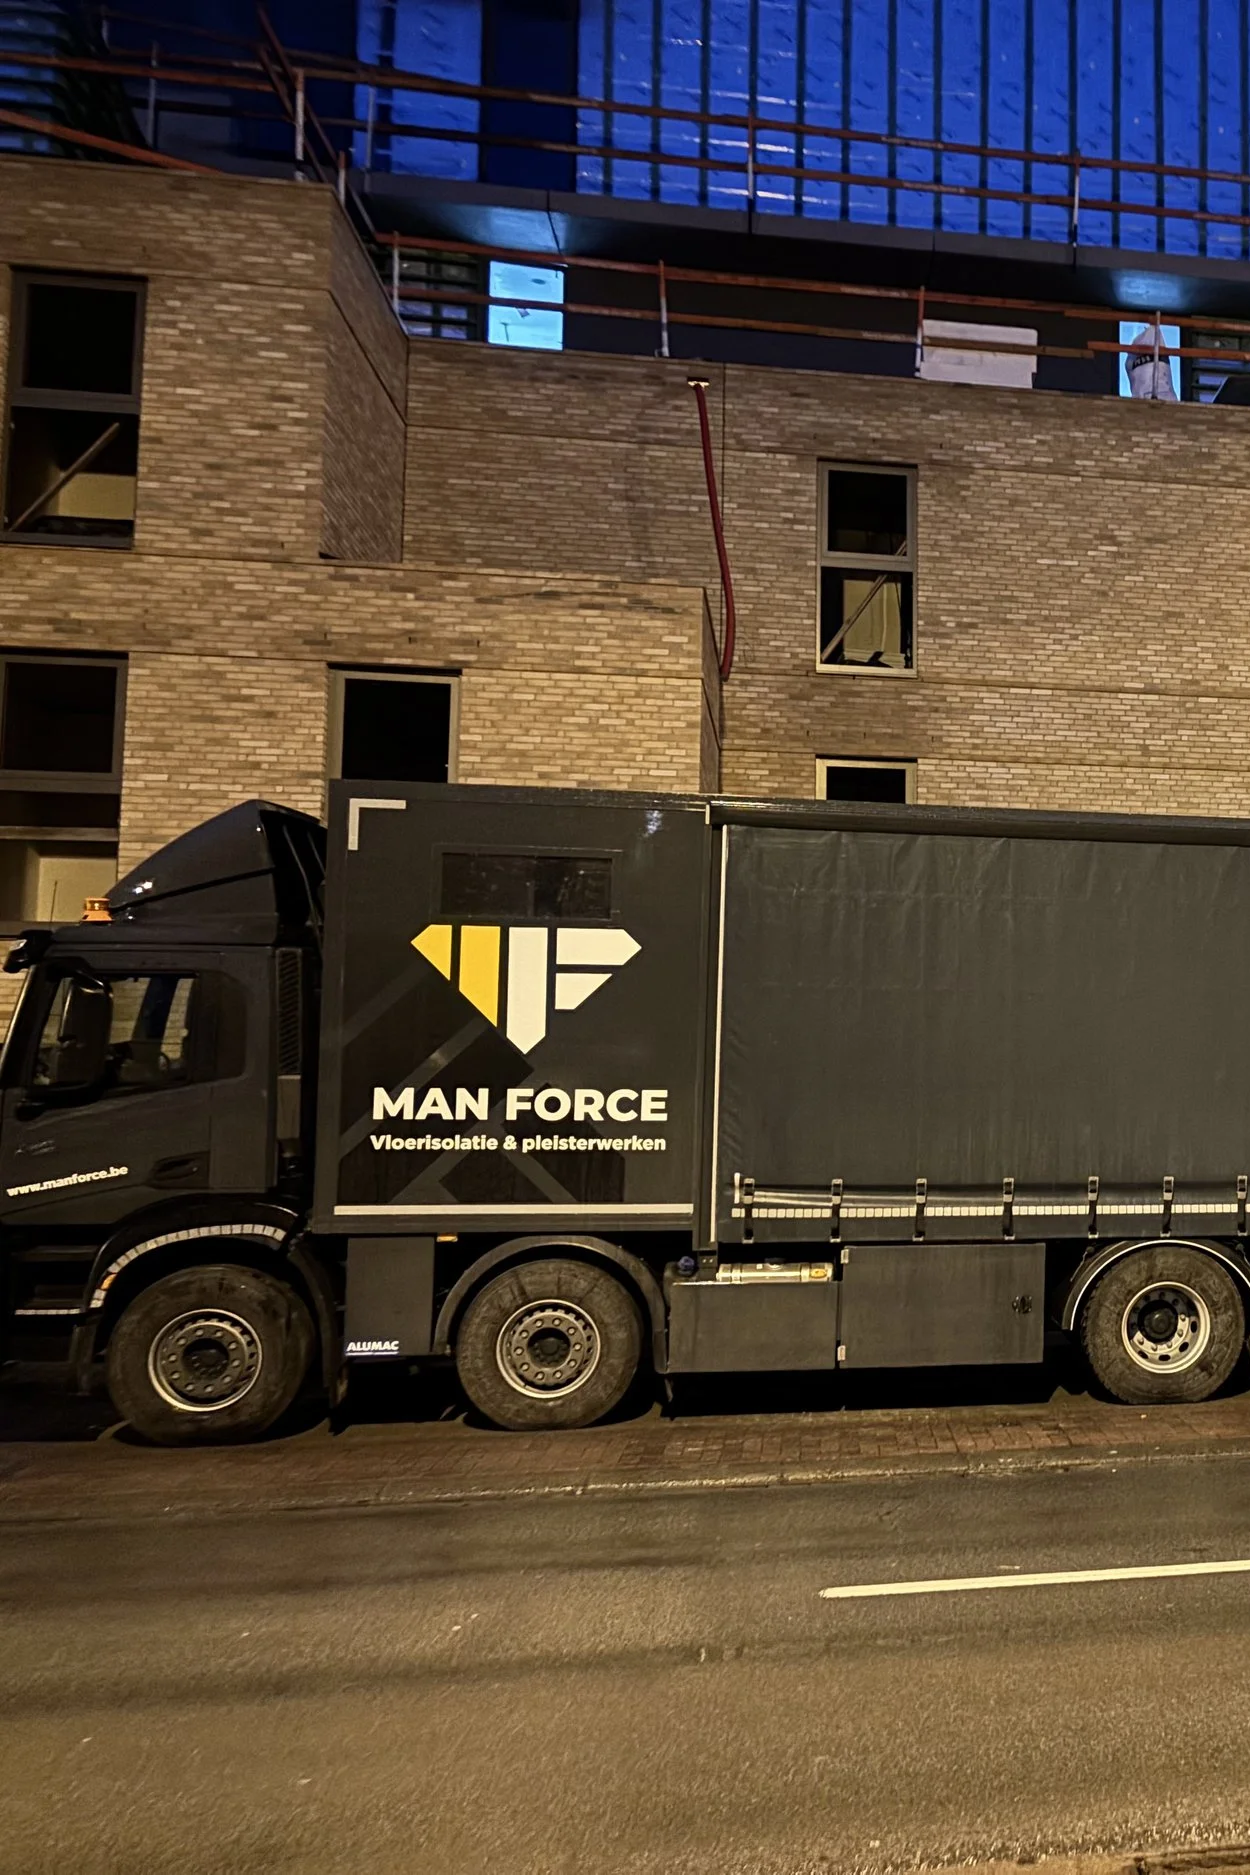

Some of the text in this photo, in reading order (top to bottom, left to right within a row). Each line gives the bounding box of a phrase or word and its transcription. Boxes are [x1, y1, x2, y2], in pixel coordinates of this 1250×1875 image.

[372, 1087, 669, 1122] MAN FORCE
[370, 1134, 667, 1153] Vloerisolatie & pleisterwerken
[6, 1166, 129, 1197] www.manforce.be
[346, 1340, 400, 1352] ALUMAC
